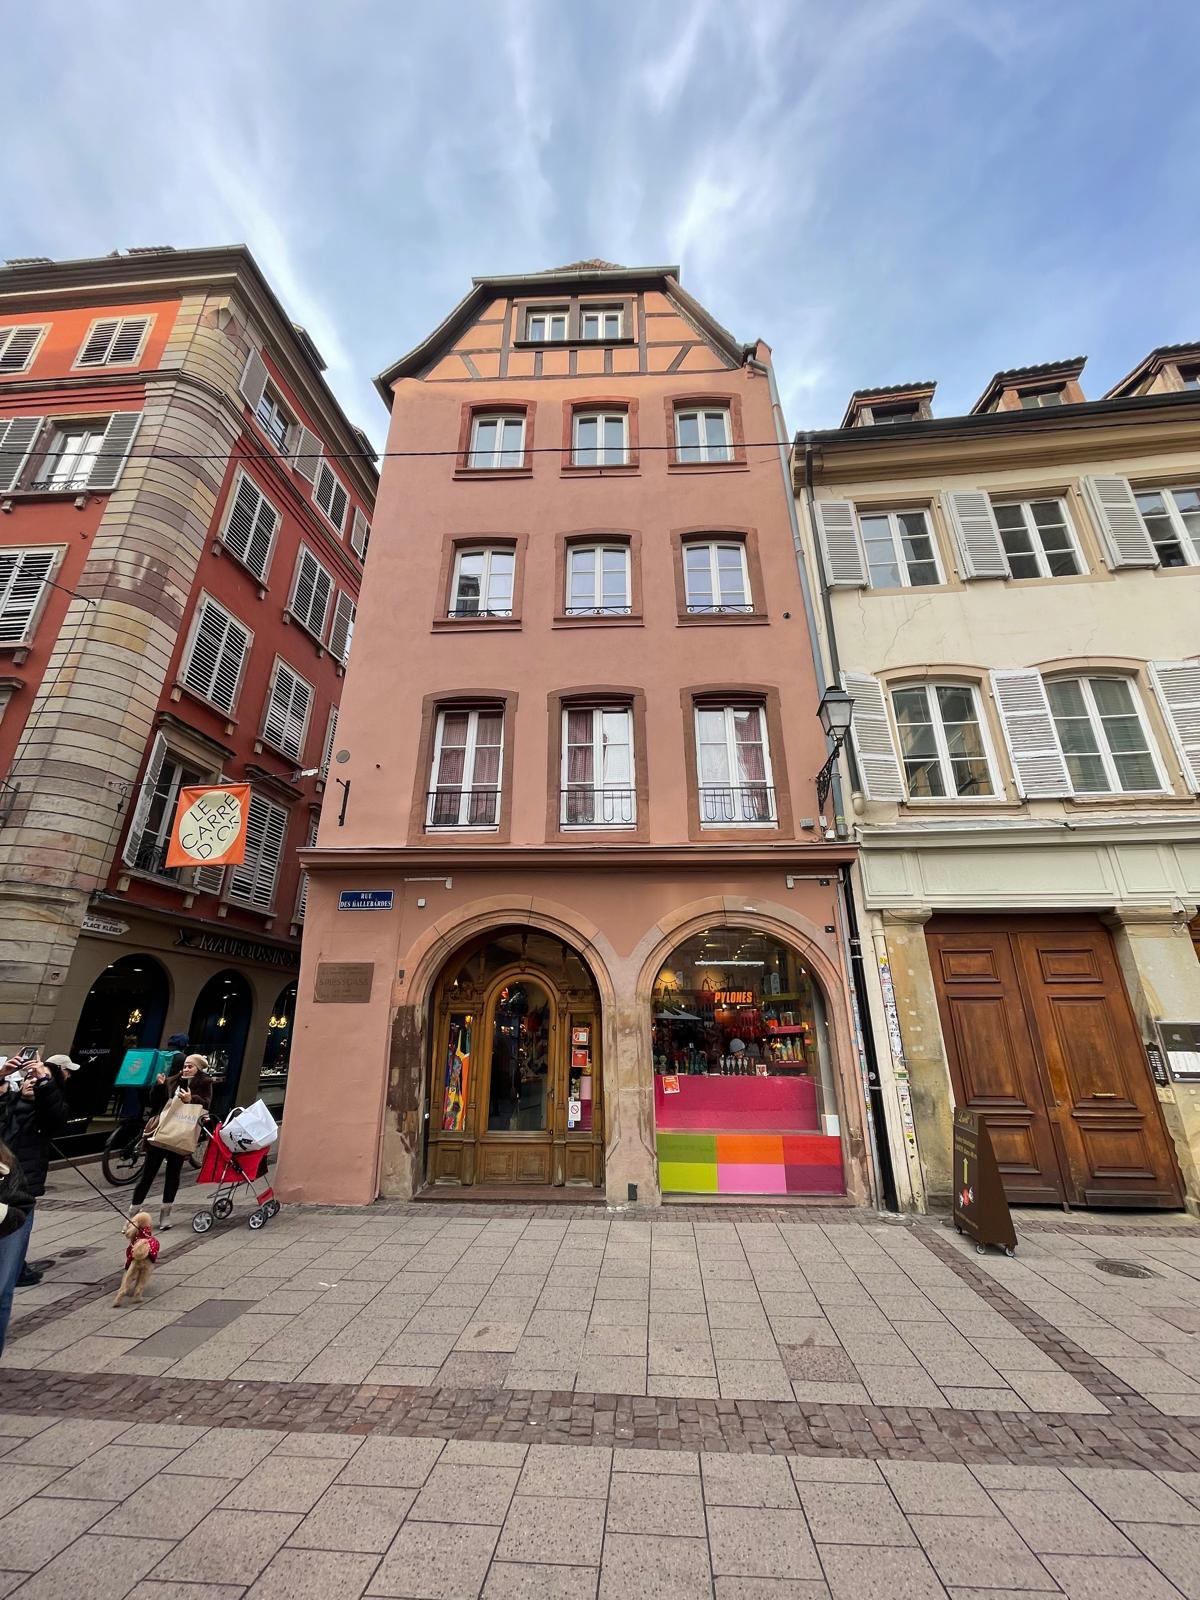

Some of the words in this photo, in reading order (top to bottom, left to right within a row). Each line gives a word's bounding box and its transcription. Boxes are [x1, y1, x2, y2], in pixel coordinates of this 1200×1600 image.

[190, 800, 212, 822] LE
[181, 793, 239, 850] CARRÉ
[351, 900, 391, 908] HALLEBARDES
[82, 921, 101, 930] PLACE
[714, 991, 753, 1004] PYLONES
